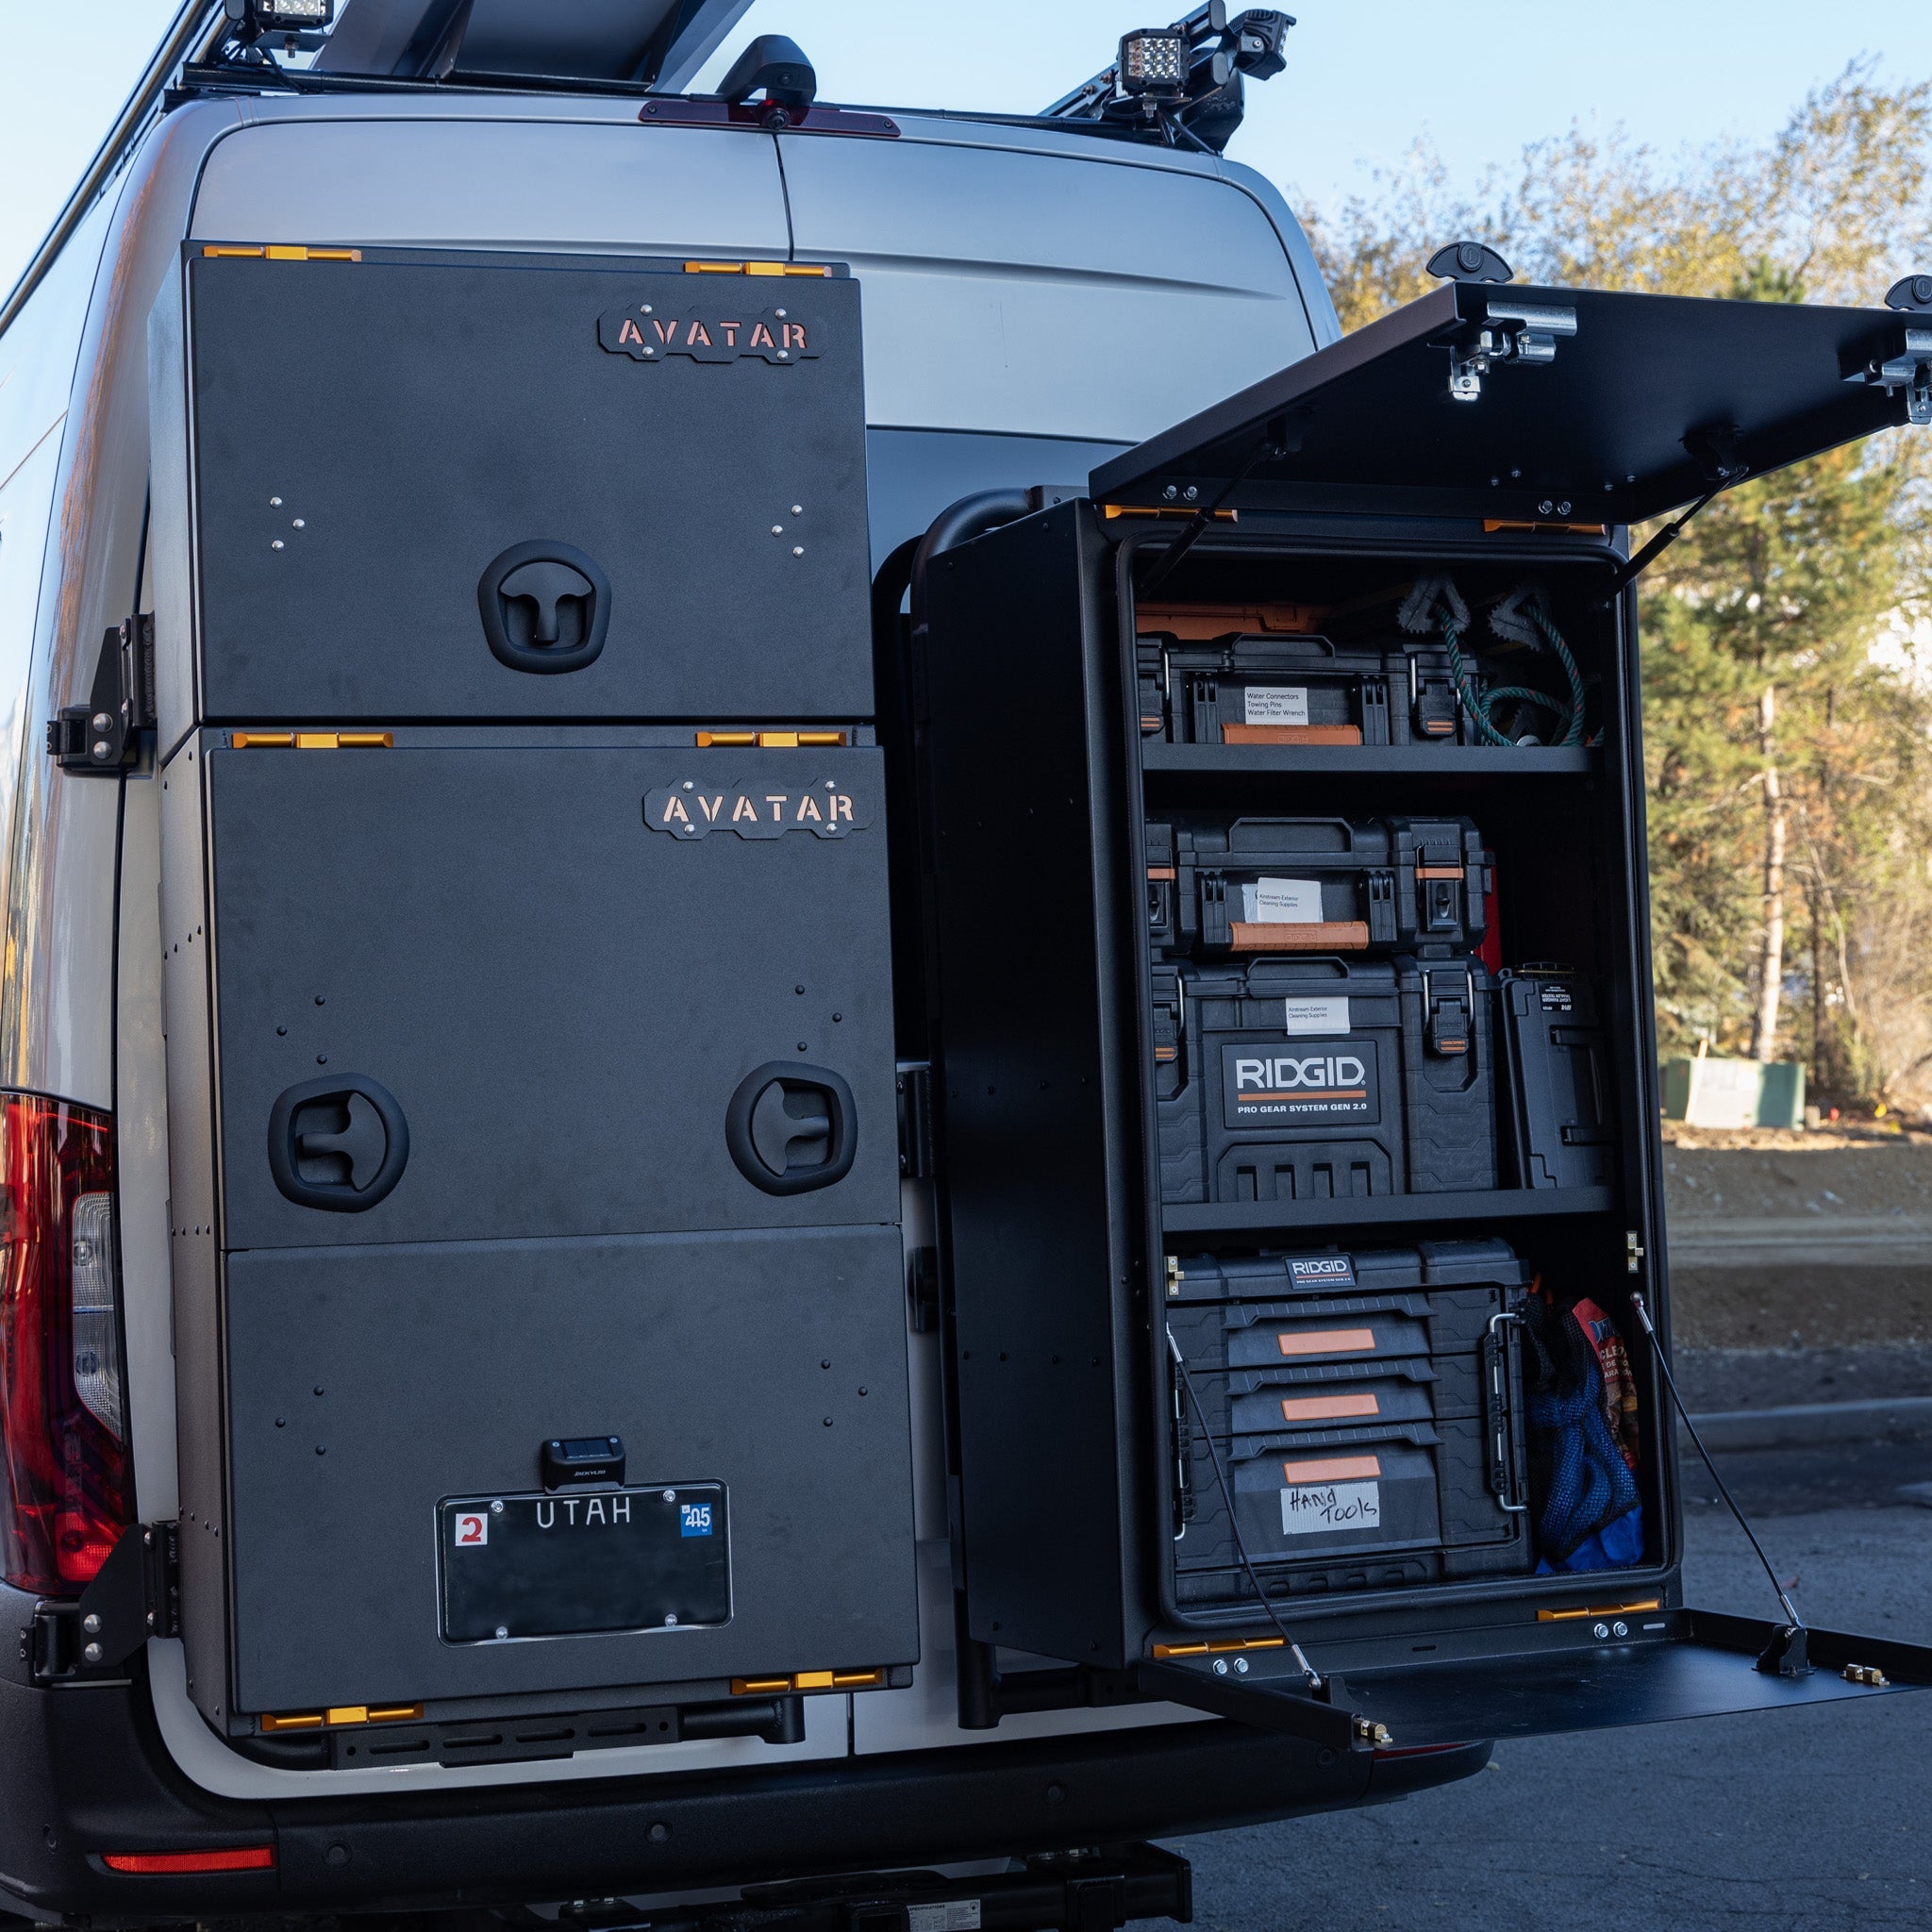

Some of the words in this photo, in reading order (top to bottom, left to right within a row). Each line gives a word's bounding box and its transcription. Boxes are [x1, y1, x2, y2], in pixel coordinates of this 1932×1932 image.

[618, 319, 808, 349] AVATAR
[1247, 701, 1269, 709] Towing
[663, 795, 854, 823] AVATAR
[1236, 1056, 1366, 1090] RIDGID
[1289, 1104, 1328, 1112] SYSTEM
[1330, 1103, 1351, 1111] GEN
[1291, 1259, 1347, 1274] RIDGID
[537, 1496, 630, 1528] UTAH
[461, 1516, 483, 1542] 2
